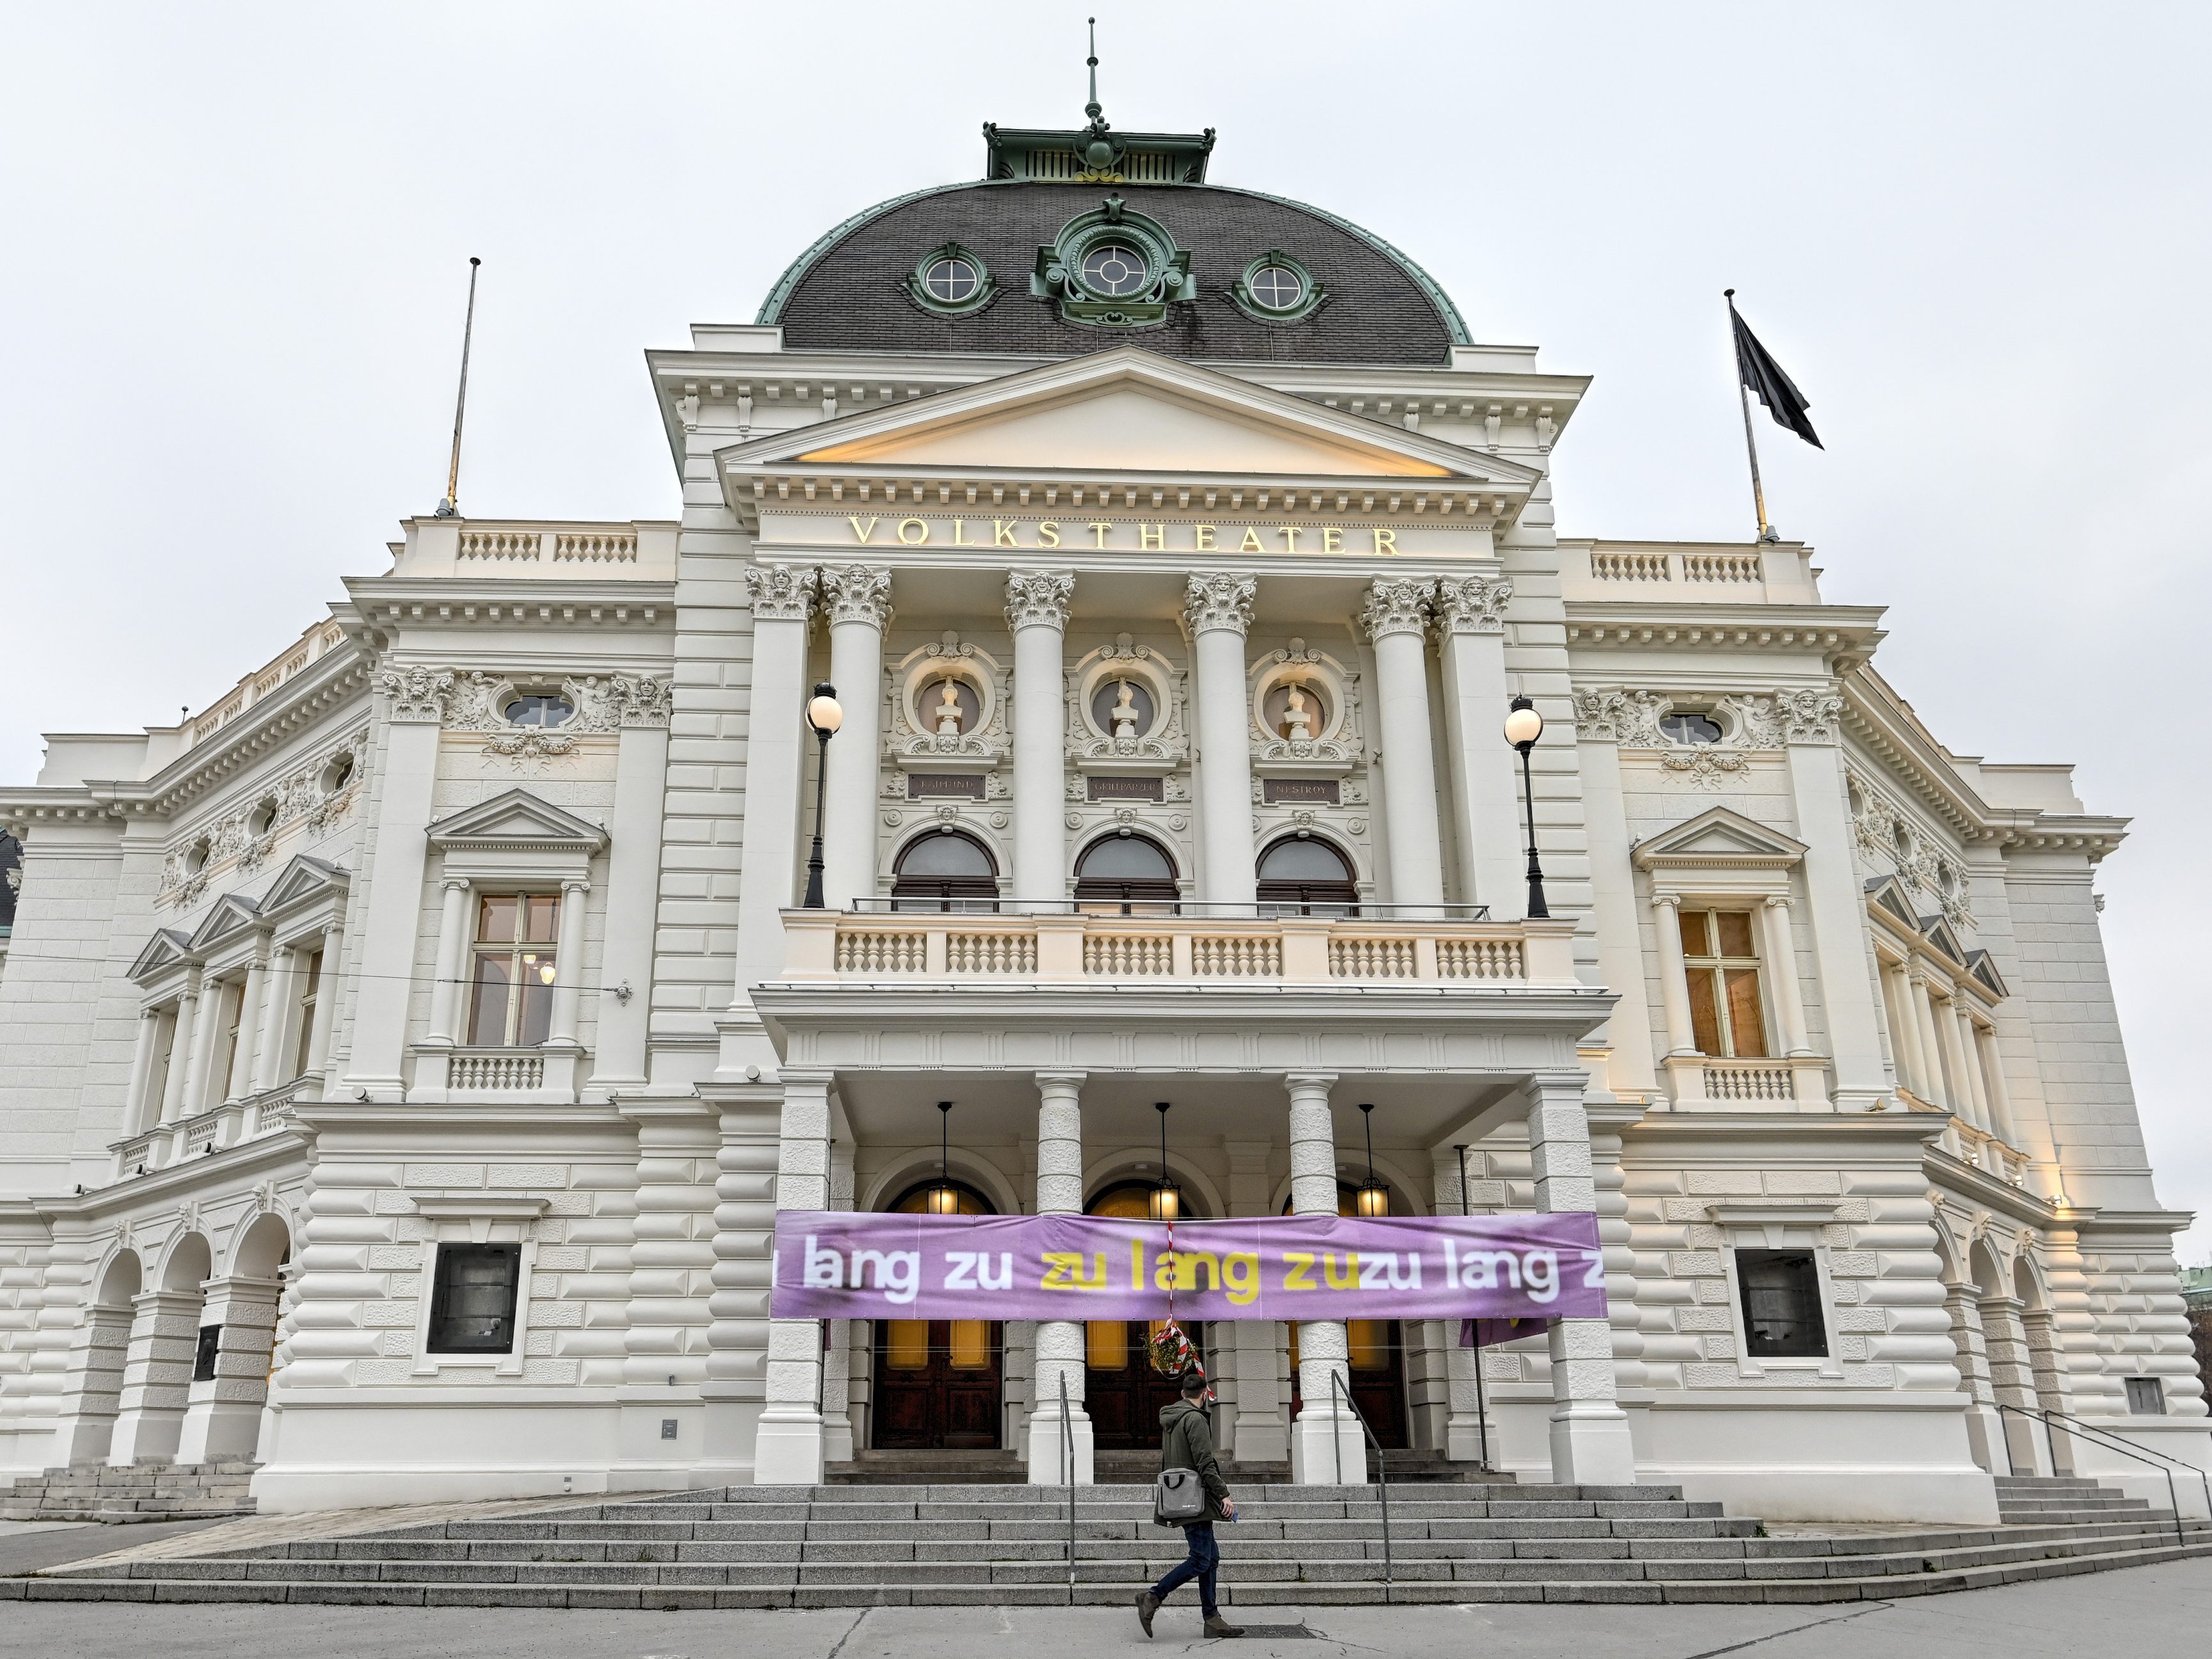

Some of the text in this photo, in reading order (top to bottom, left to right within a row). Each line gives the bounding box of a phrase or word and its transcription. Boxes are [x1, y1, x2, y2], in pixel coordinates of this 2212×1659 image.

[848, 516, 1401, 556] VOLKSTHEATER
[1276, 785, 1326, 794] NESTROY
[804, 1235, 920, 1304] lang
[944, 1252, 1012, 1290] zu
[1040, 1252, 1106, 1290] zu
[1444, 1239, 1560, 1303] lang
